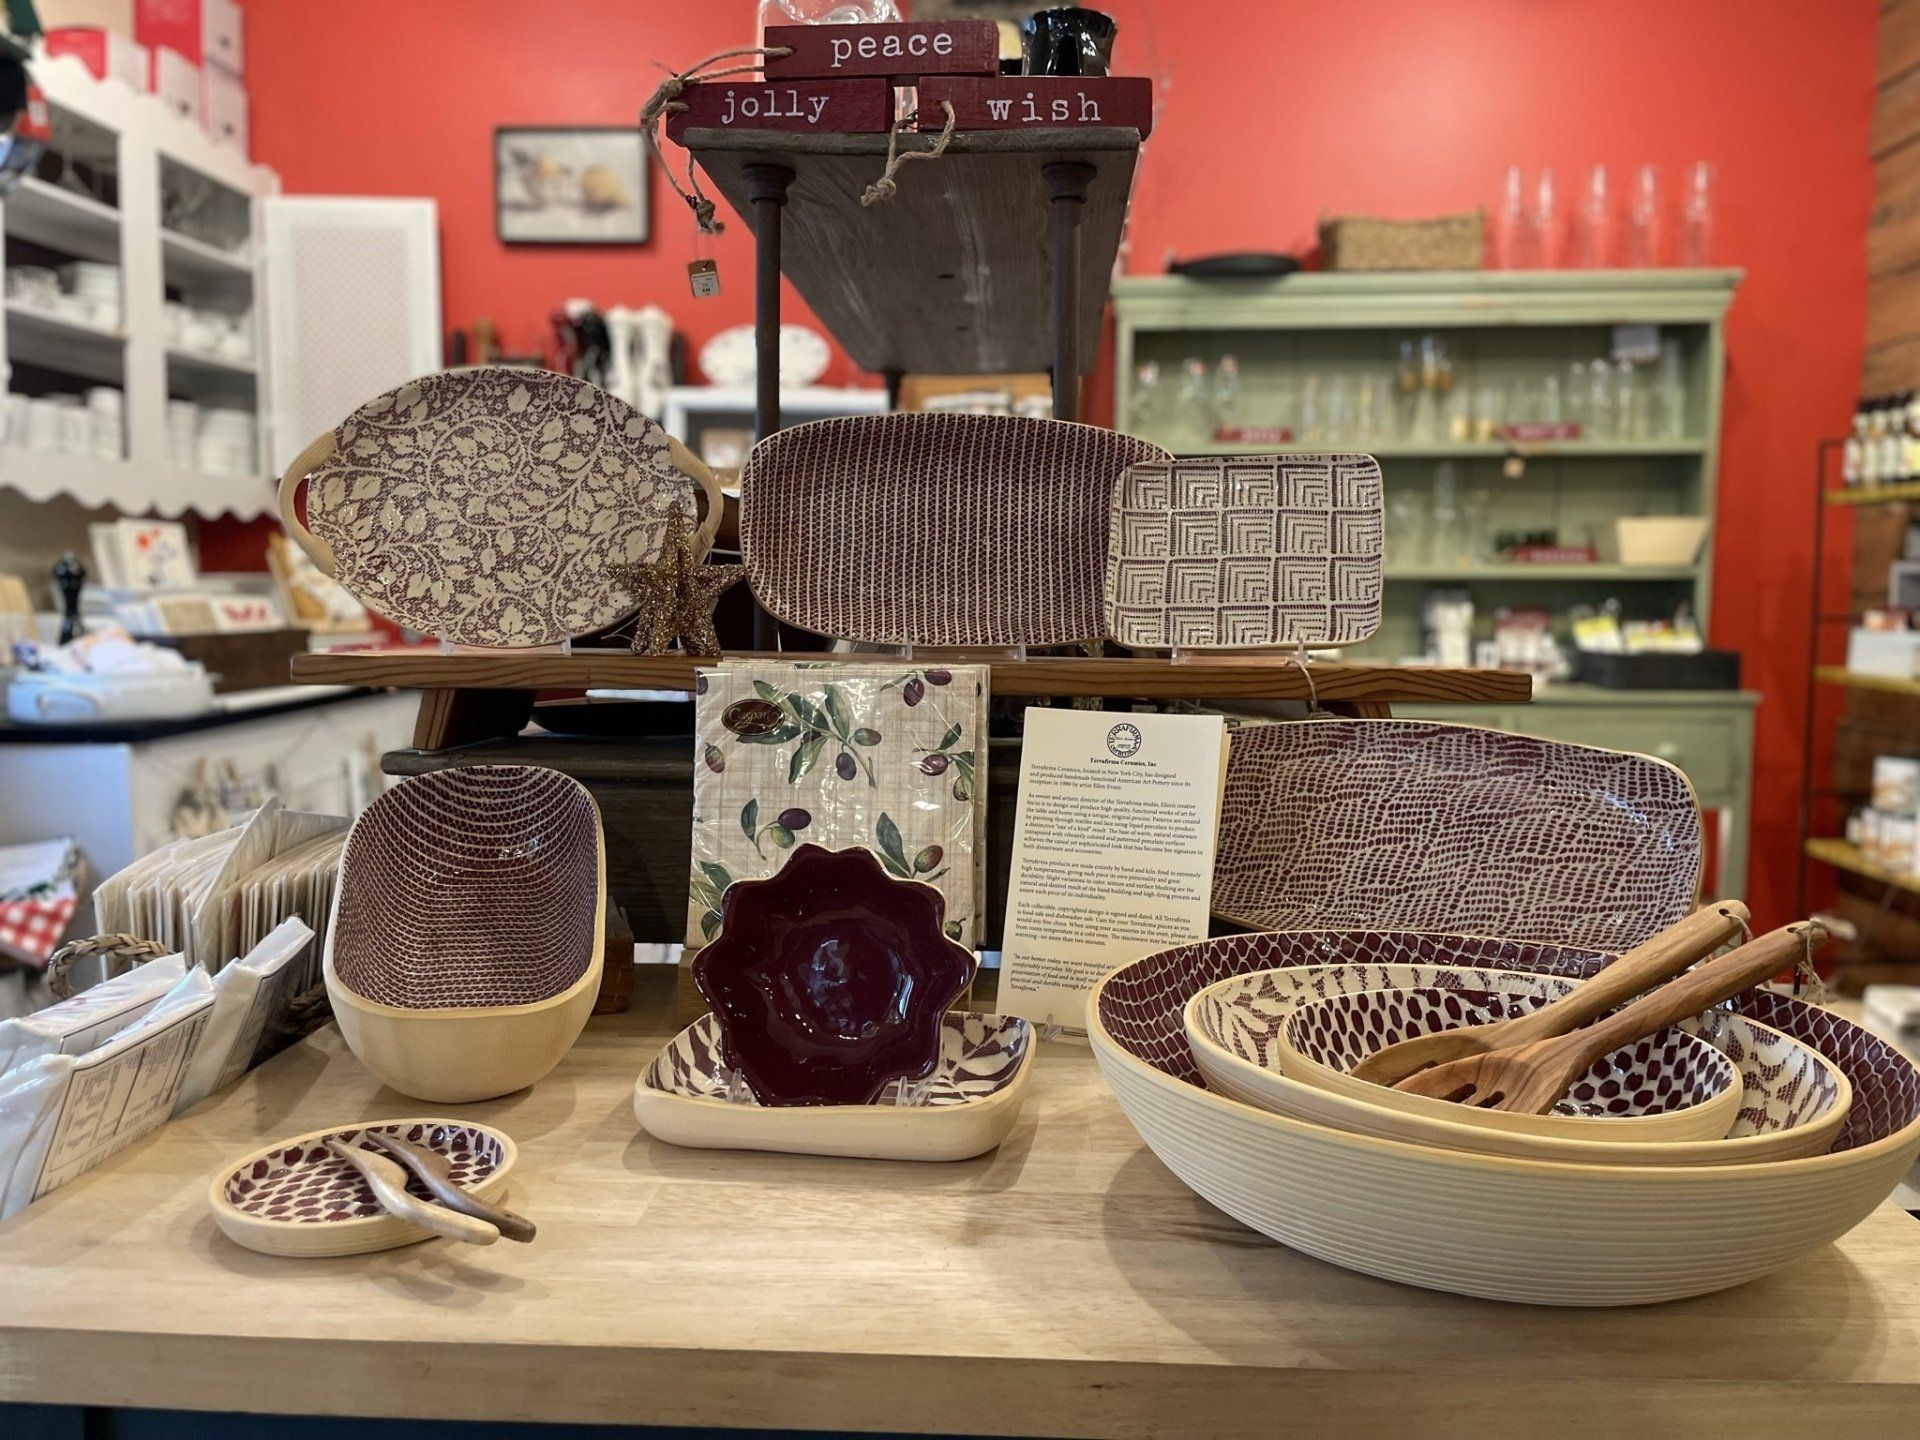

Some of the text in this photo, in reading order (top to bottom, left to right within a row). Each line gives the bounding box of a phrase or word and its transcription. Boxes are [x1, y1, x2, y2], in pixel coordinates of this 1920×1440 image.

[831, 33, 953, 68] peace
[721, 89, 830, 125] jolly
[986, 92, 1102, 121] wish
